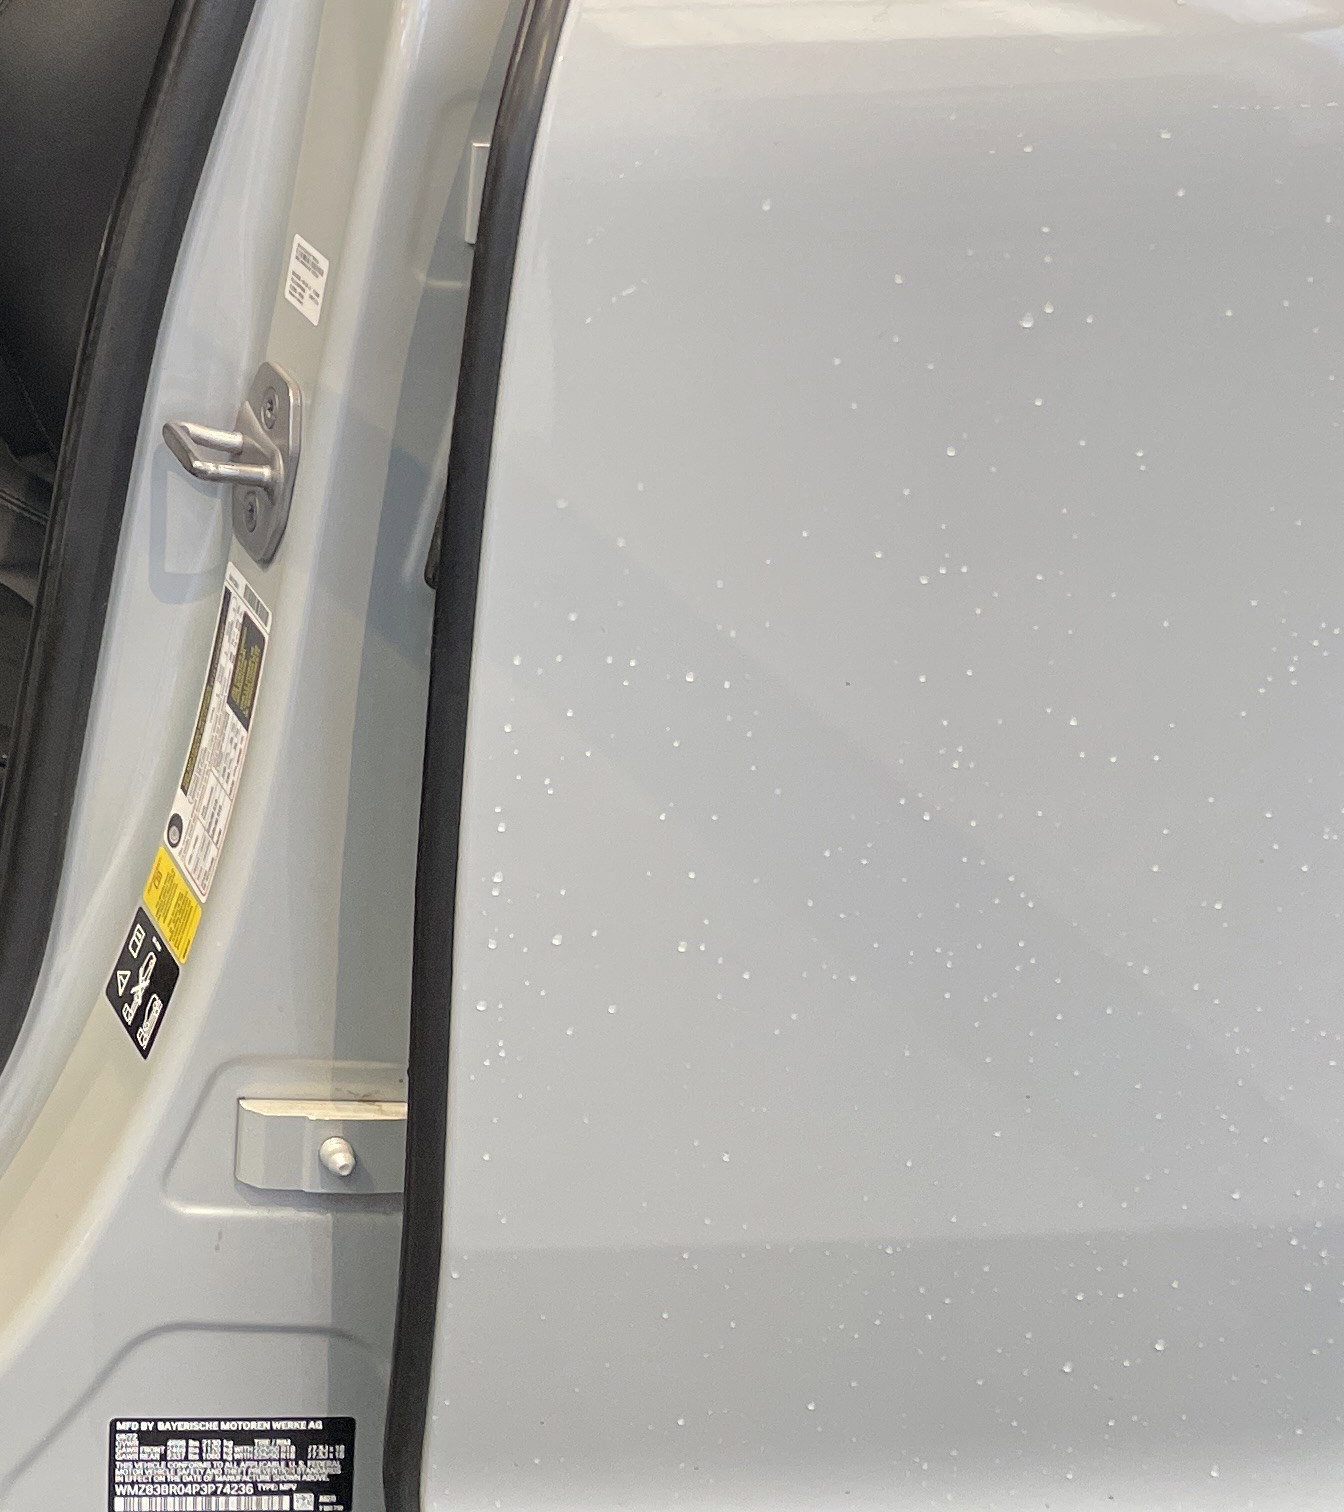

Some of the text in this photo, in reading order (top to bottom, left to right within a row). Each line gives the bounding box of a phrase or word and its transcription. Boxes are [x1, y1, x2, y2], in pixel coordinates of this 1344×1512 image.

[116, 1420, 323, 1431] MFD BY BAYERISCHE MOTOREN WERKE AG
[278, 1483, 297, 1491] MPV
